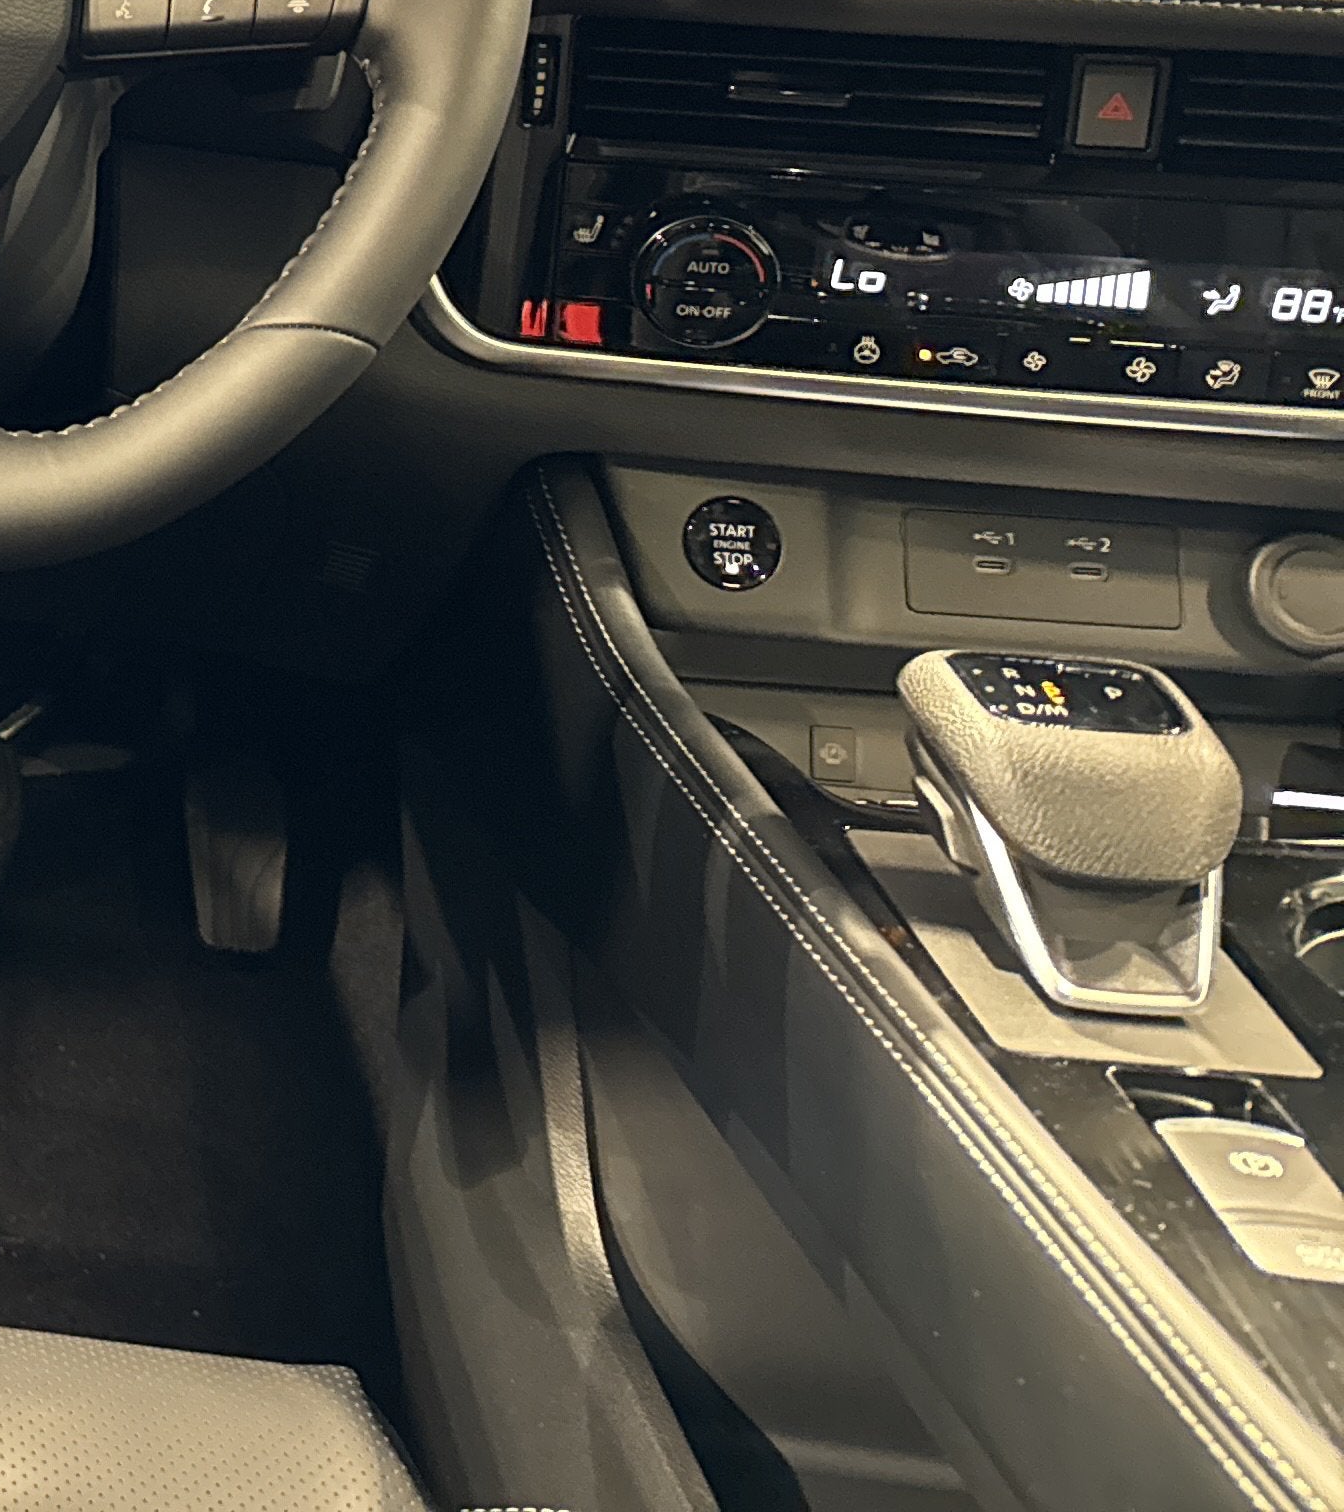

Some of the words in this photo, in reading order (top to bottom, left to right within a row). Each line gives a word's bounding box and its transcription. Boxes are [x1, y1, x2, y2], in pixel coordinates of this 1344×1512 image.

[687, 261, 730, 275] AUTO
[709, 522, 756, 539] START
[713, 539, 752, 551] ENGINE
[1004, 532, 1016, 546] 1
[1097, 537, 1112, 553] 2
[712, 551, 753, 566] STOP
[1000, 667, 1021, 680] R
[1013, 684, 1036, 698] N
[1016, 702, 1069, 718] D/M
